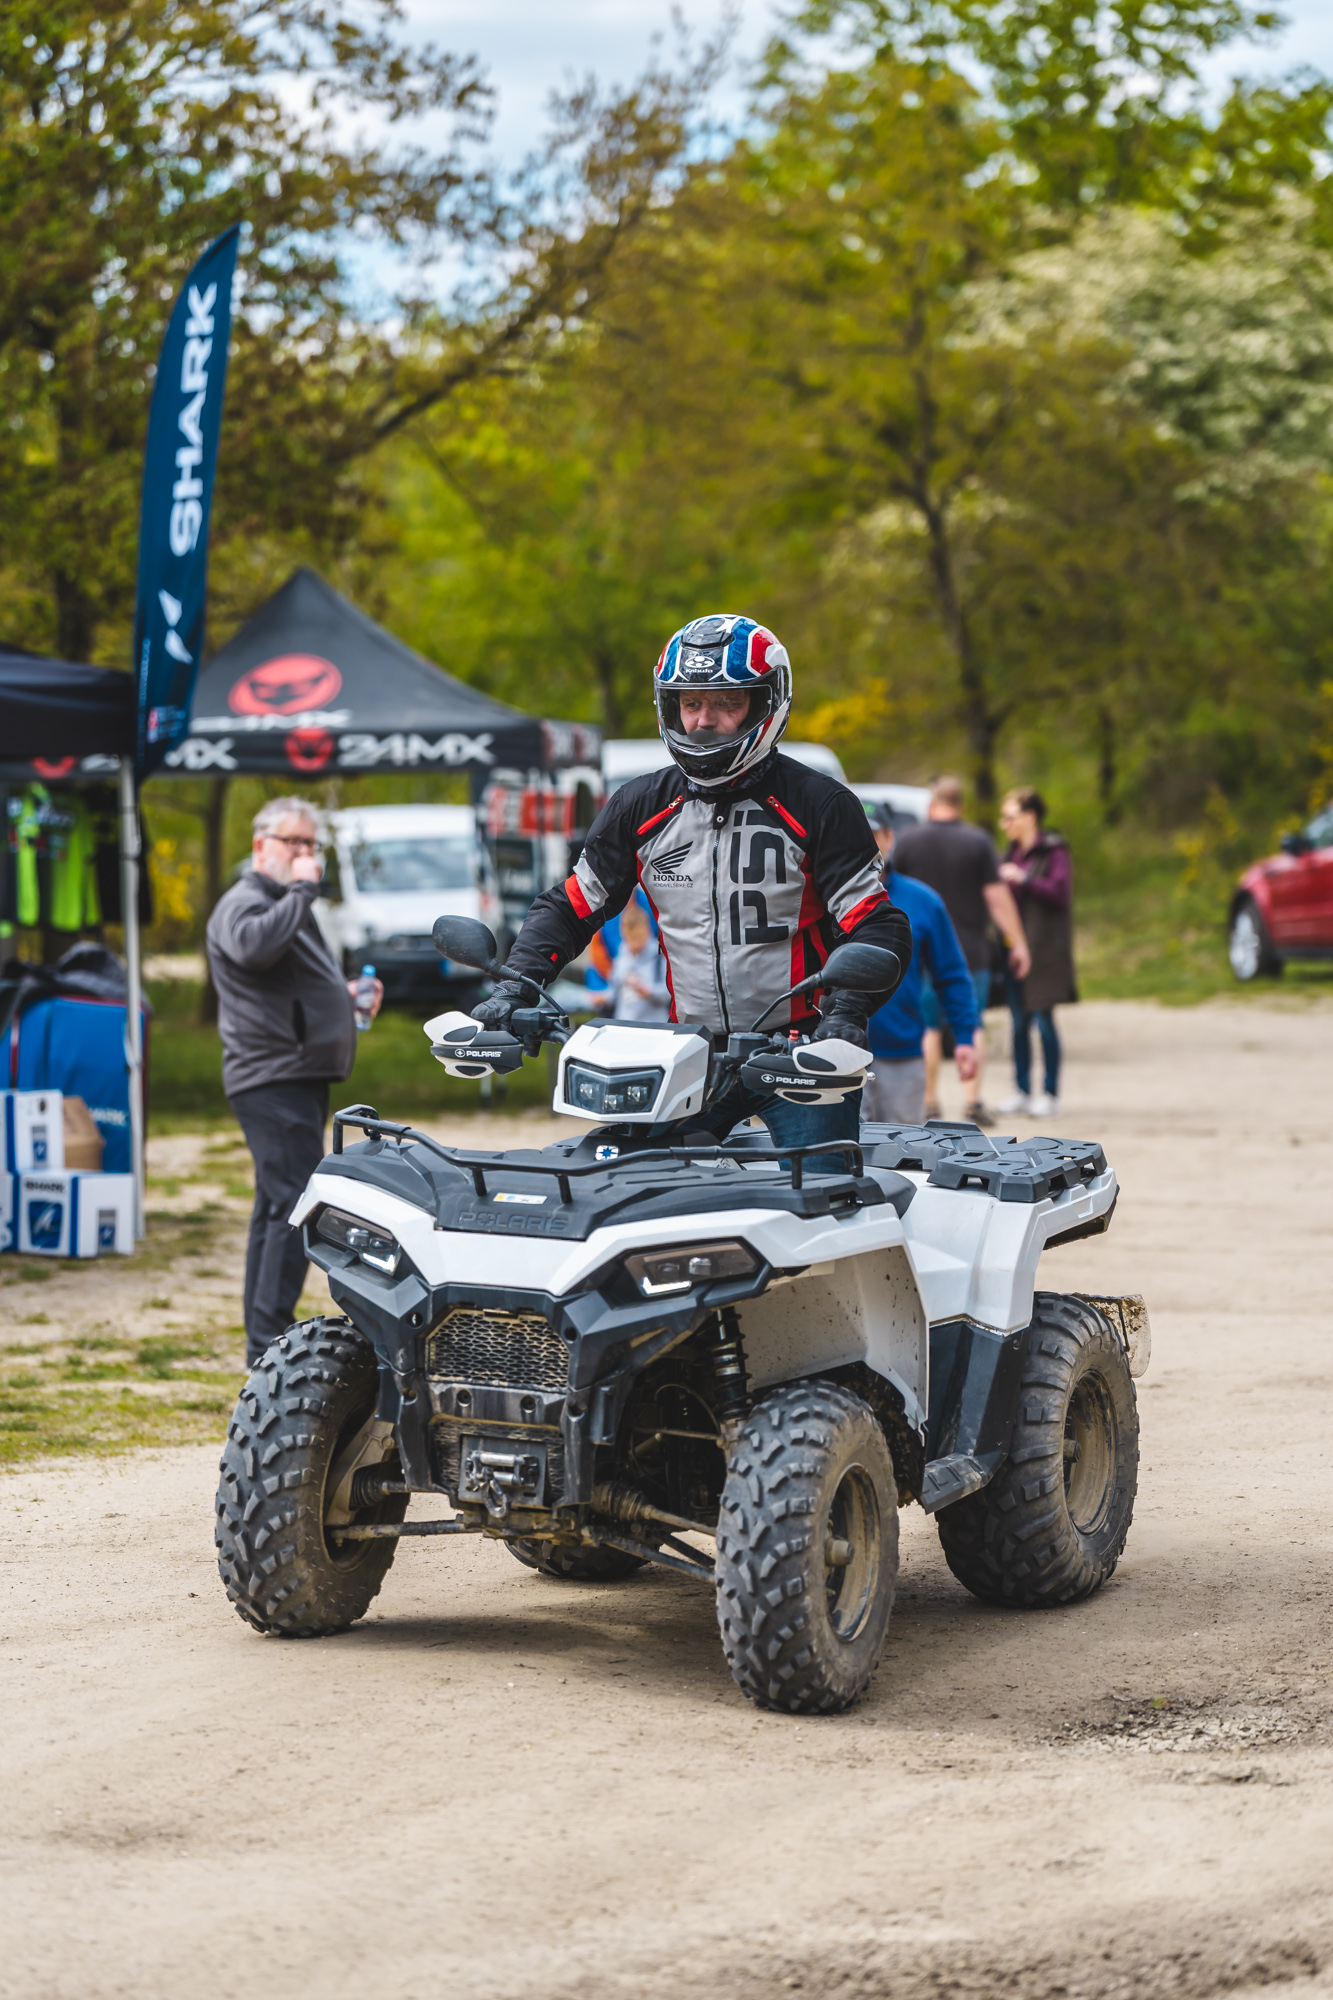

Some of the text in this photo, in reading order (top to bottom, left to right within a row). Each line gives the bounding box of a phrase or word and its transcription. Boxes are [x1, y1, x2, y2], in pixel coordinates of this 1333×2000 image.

[169, 281, 218, 557] SHARK
[336, 733, 496, 767] 24MX
[653, 874, 693, 882] HONDA
[466, 1050, 502, 1058] POLARIS
[775, 1076, 817, 1086] POLARIS
[459, 1211, 570, 1233] POLARIS
